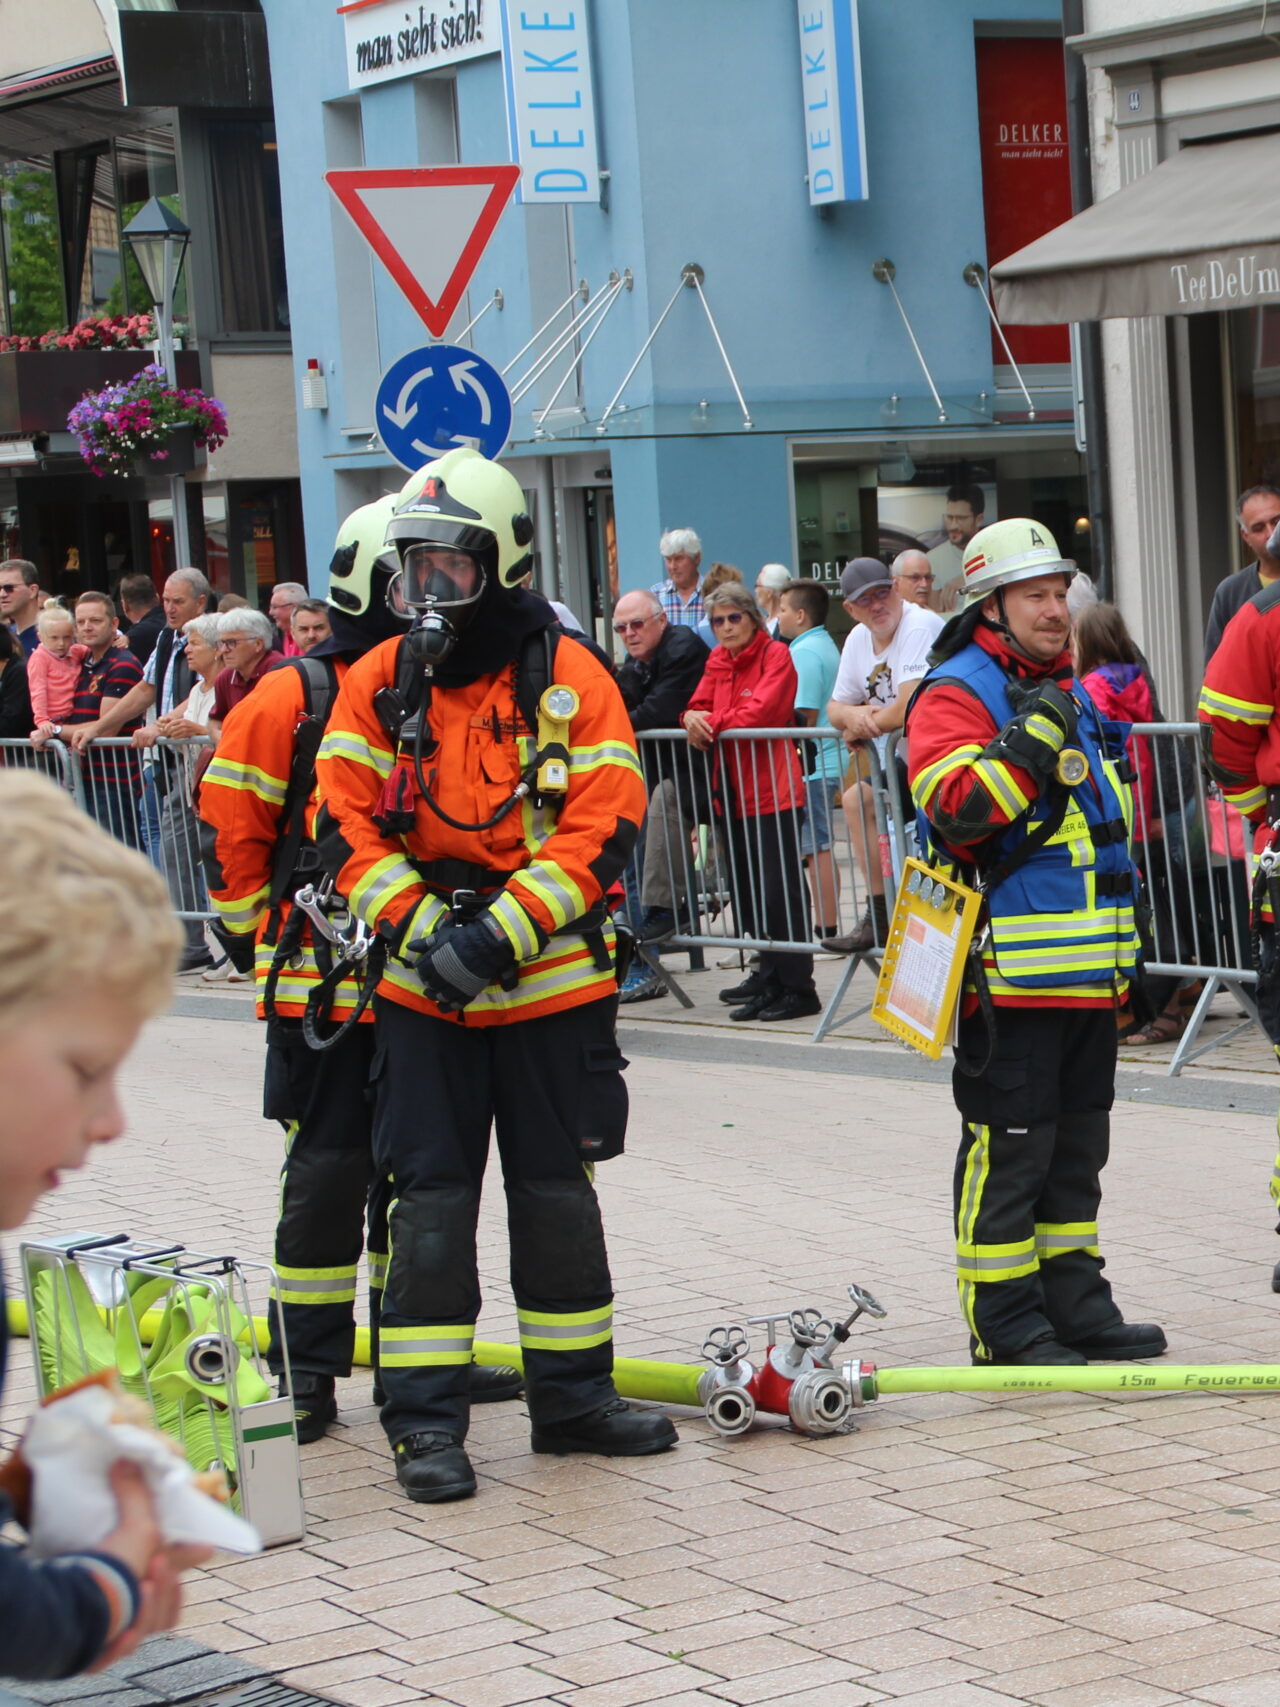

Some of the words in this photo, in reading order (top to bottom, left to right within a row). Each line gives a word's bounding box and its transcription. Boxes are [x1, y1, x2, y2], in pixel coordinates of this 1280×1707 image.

[356, 34, 393, 72] man
[397, 6, 437, 61] sieht
[441, 0, 482, 47] sich!
[1000, 123, 1062, 142] DELKER
[1022, 149, 1041, 158] sieht
[1043, 149, 1063, 158] sich!
[1170, 255, 1280, 304] TeeDeUm
[420, 479, 437, 498] A
[1030, 527, 1045, 546] A
[812, 561, 849, 581] DEL
[1118, 1374, 1156, 1387] 15m
